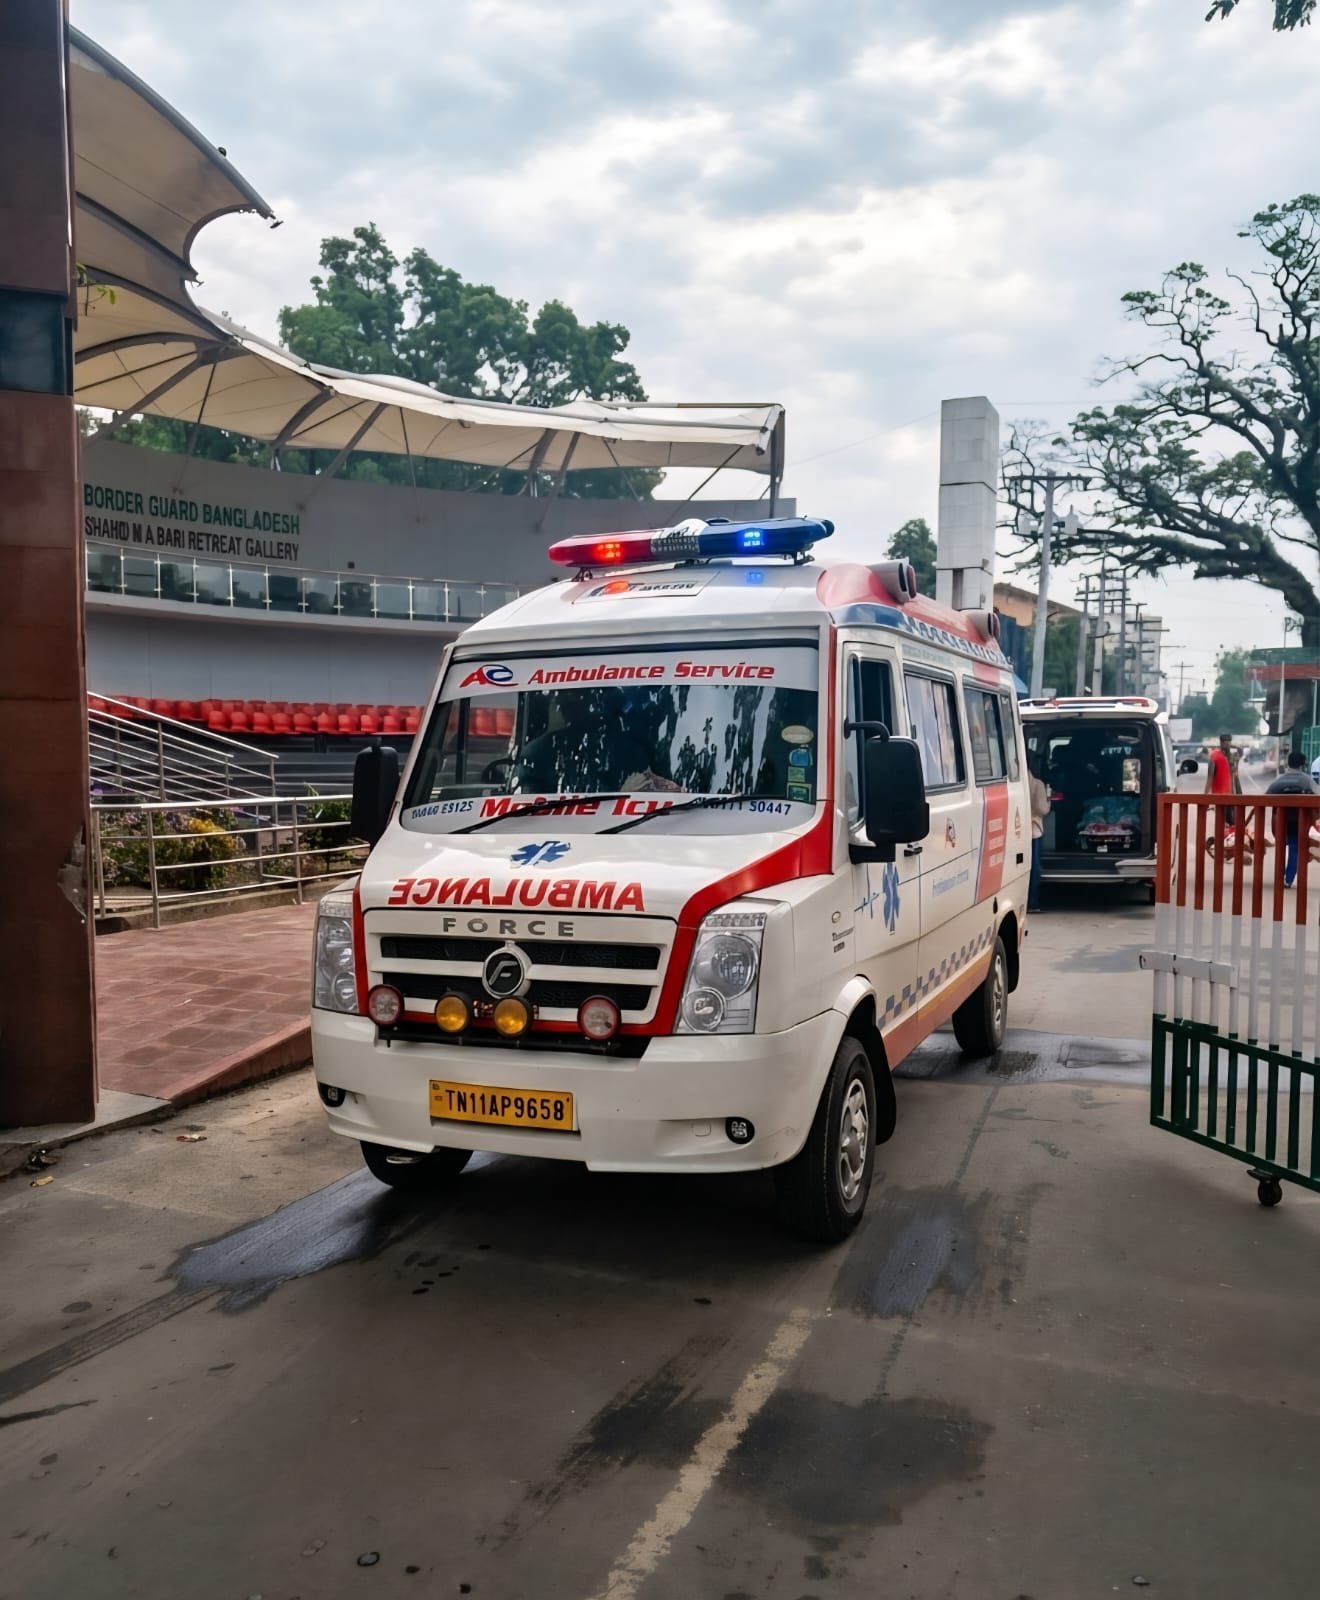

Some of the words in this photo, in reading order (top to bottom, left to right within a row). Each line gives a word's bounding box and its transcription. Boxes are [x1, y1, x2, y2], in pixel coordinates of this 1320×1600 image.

[84, 484, 144, 515] BORDER
[149, 495, 198, 522] GUARD
[203, 503, 300, 535] BANGLADESH
[145, 525, 154, 545] A
[156, 526, 185, 549] BARI
[188, 530, 242, 556] RETREAT
[246, 538, 299, 561] GALLERY
[528, 664, 665, 684] Ambulance
[674, 661, 775, 679] Service
[442, 917, 575, 937] FORCE
[445, 1089, 565, 1122] TN11AP9658
